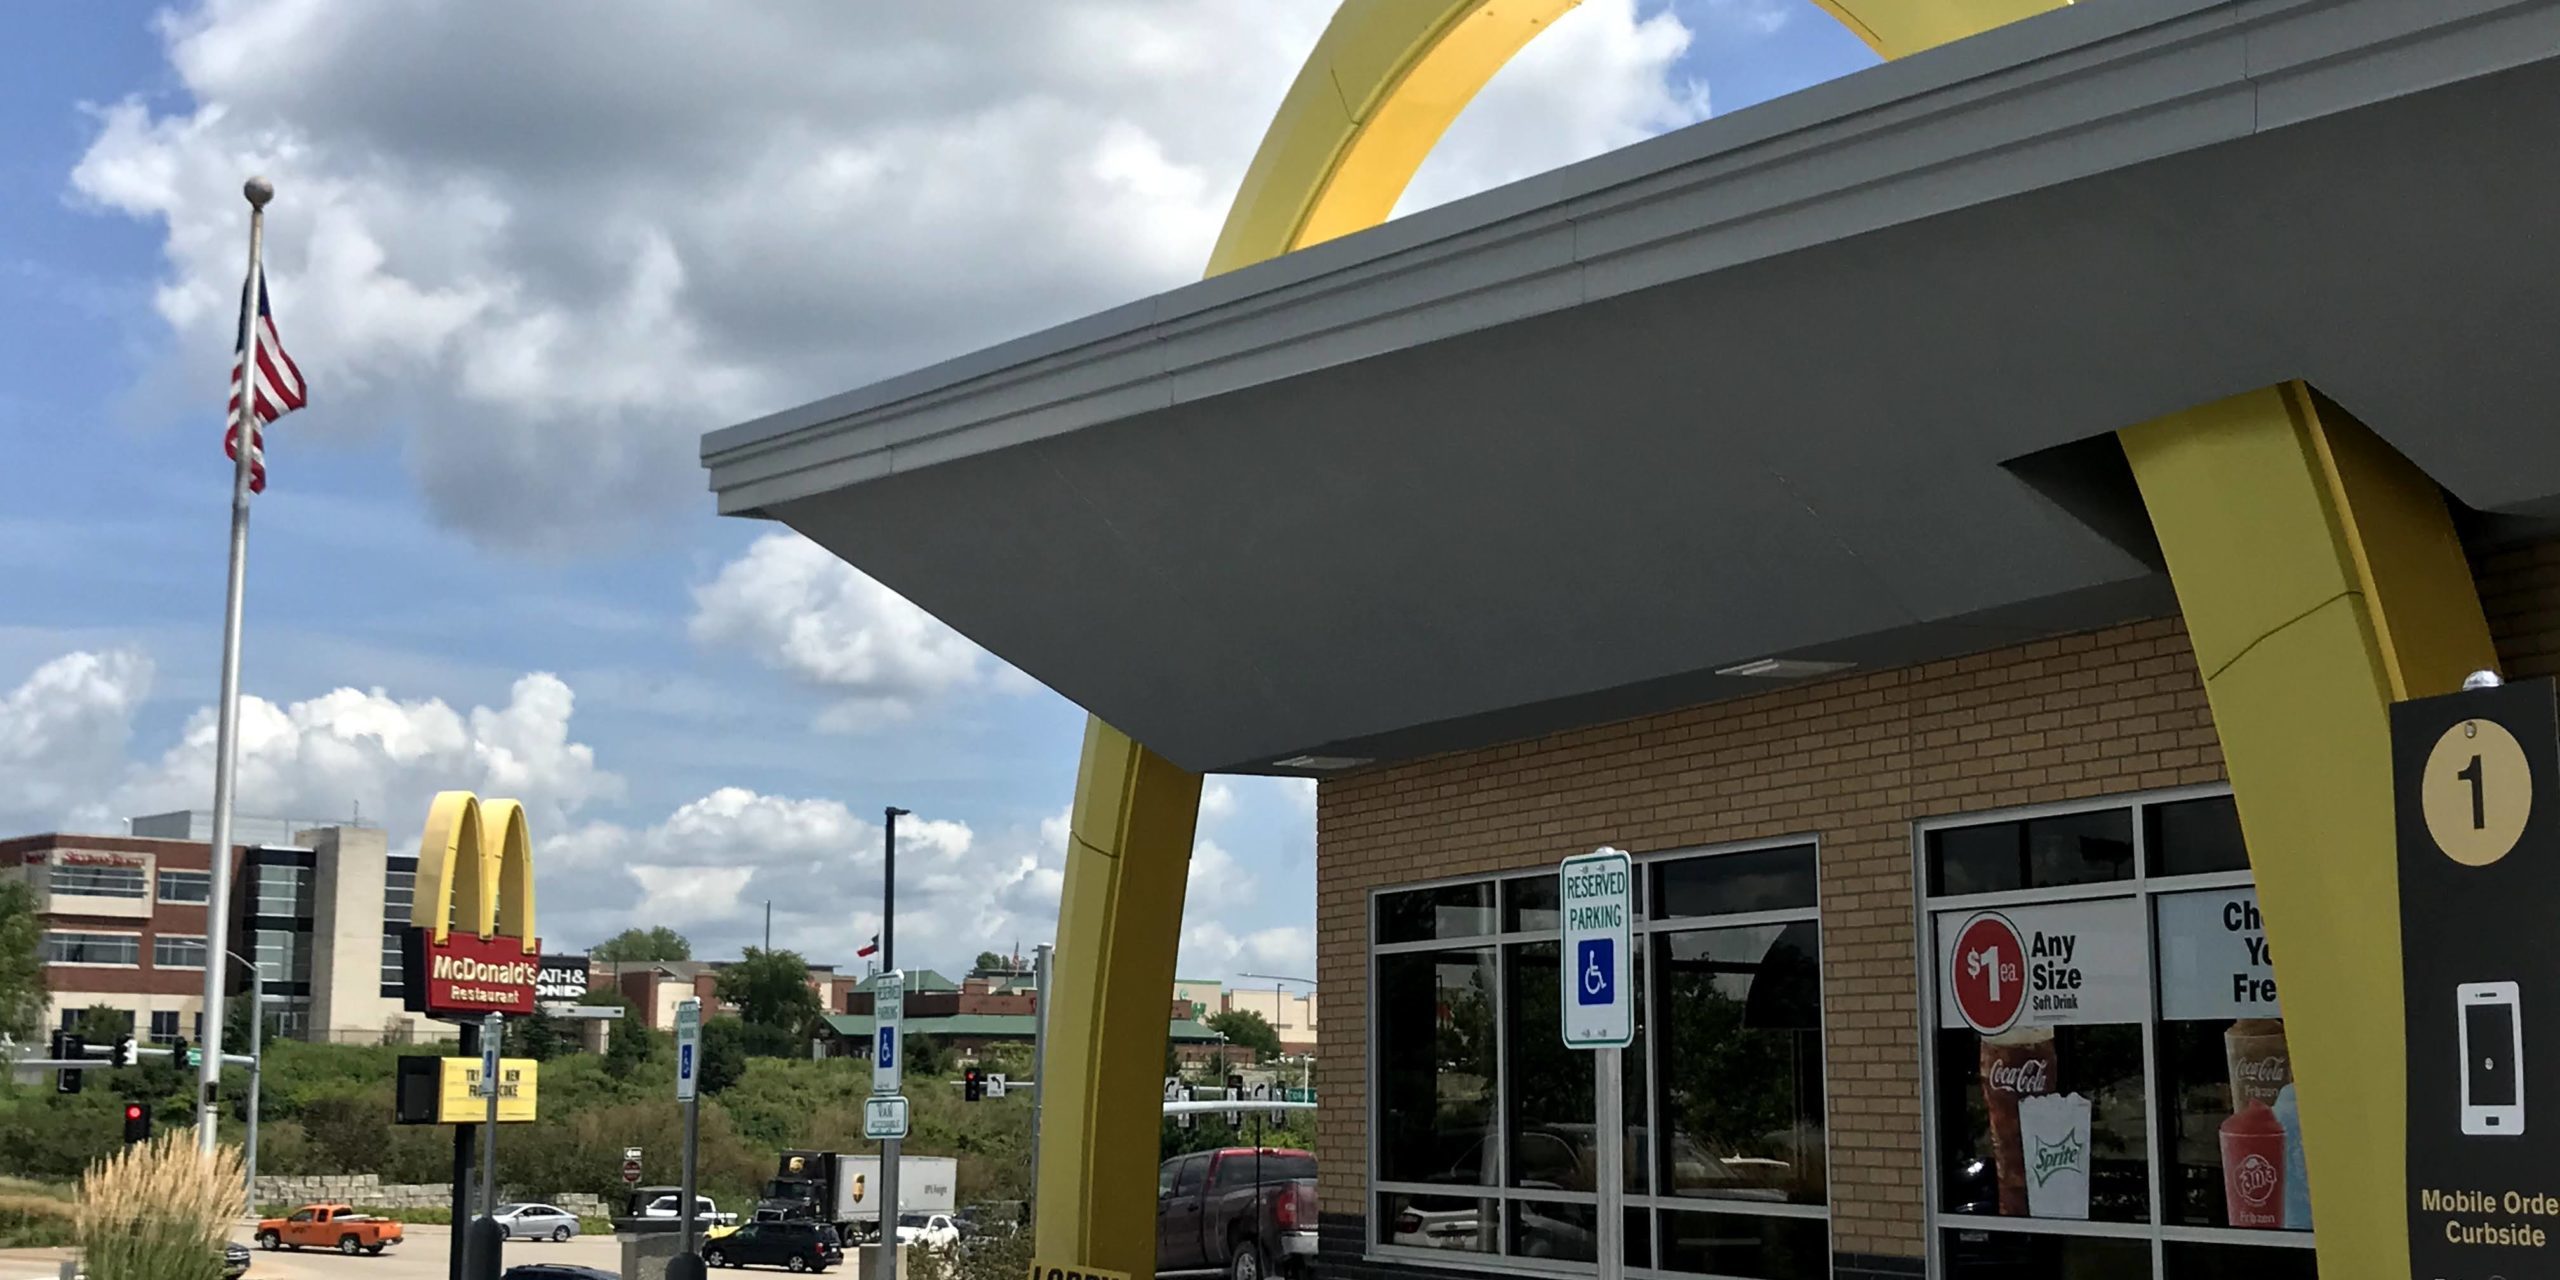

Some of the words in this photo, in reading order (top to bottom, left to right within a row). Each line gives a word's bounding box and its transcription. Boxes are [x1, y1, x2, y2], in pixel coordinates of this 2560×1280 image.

[2457, 754, 2485, 830] 1
[1567, 871, 1626, 900] RESERVED
[1569, 904, 1622, 931] PARKING
[2223, 900, 2264, 931] Ch
[2031, 931, 2076, 964] Any
[432, 954, 537, 986] McDonald's
[572, 968, 587, 984] &
[2032, 961, 2082, 991] Size
[450, 985, 520, 1004] Restaurant
[2033, 995, 2052, 1011] Soft
[2053, 993, 2079, 1010] Drink
[2036, 1145, 2078, 1172] Sprite
[2421, 1189, 2497, 1213] Mobile
[2445, 1220, 2547, 1247] Curbside
